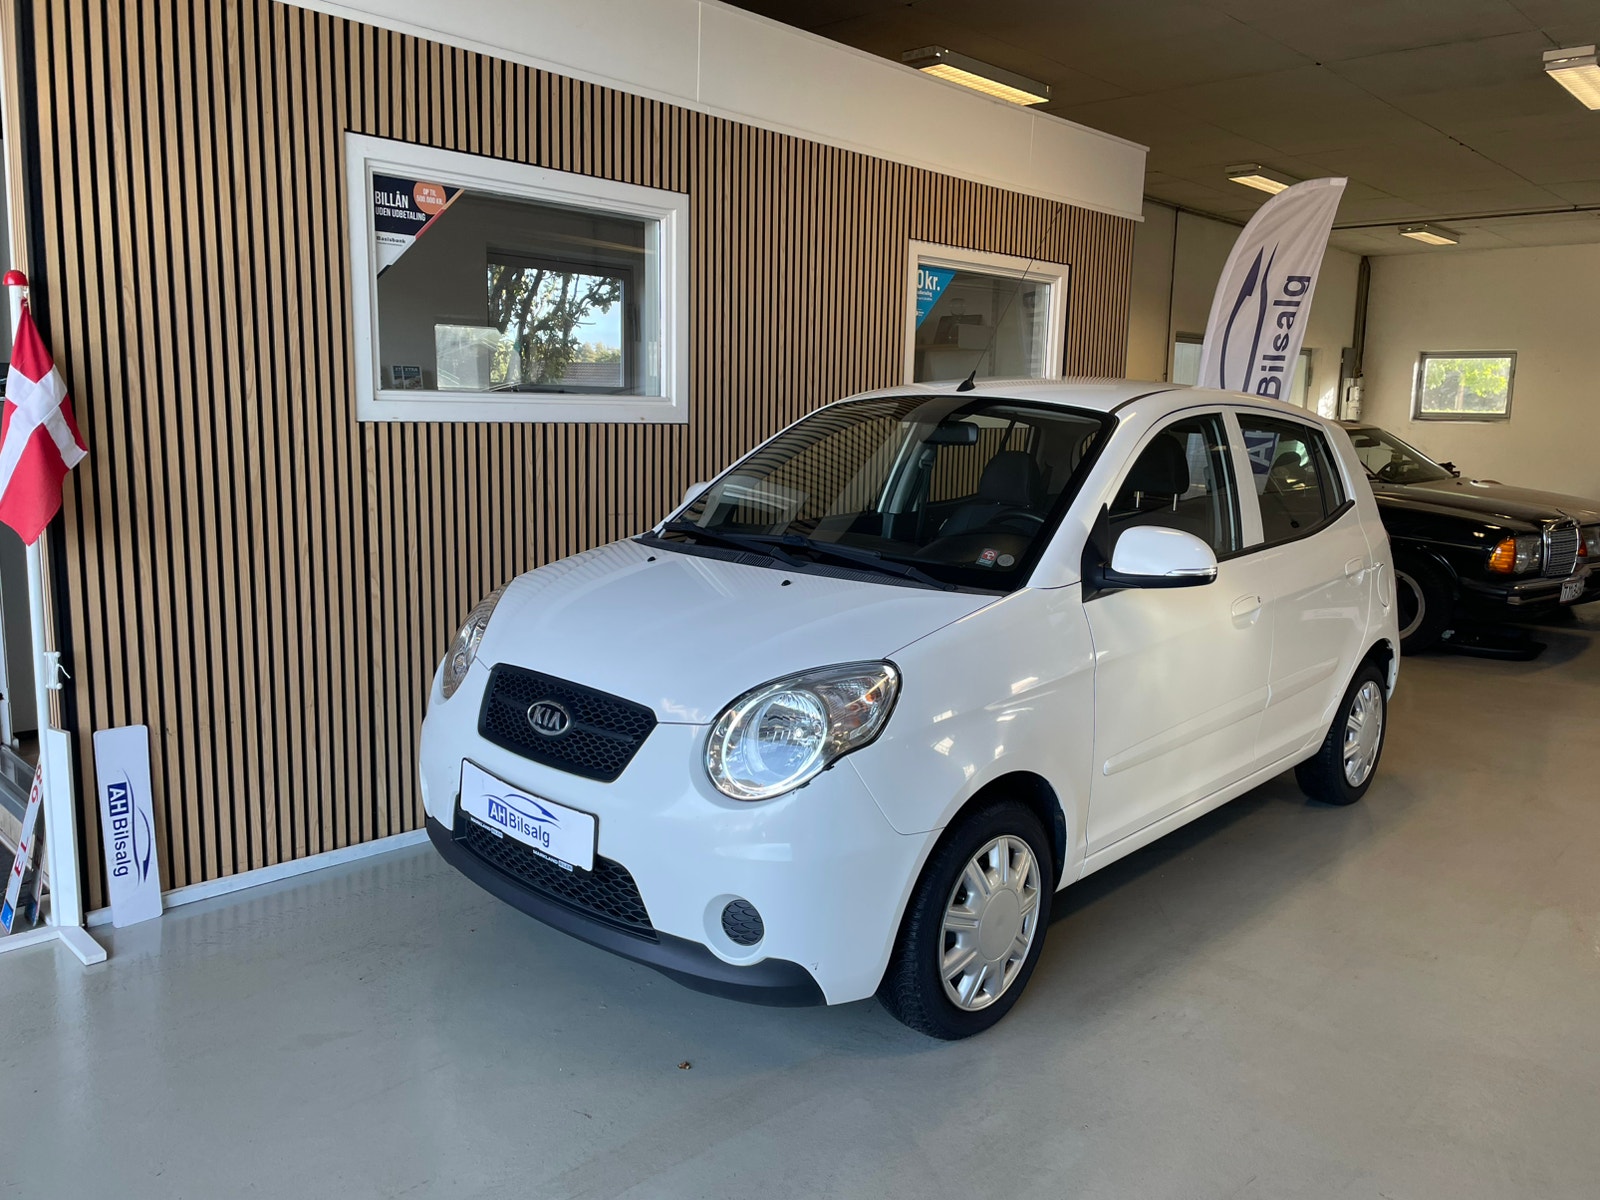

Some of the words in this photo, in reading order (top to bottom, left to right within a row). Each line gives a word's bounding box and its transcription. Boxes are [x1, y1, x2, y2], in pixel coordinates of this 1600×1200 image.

[375, 190, 409, 208] BILLÅN
[375, 206, 391, 217] UDEN
[391, 208, 426, 222] UDBETALING
[1256, 275, 1312, 400] Bilsalg
[532, 705, 561, 731] KIA
[109, 787, 128, 814] AH
[489, 801, 508, 827] AH
[508, 811, 551, 849] Bilsalg
[113, 818, 132, 877] Bilsalg
